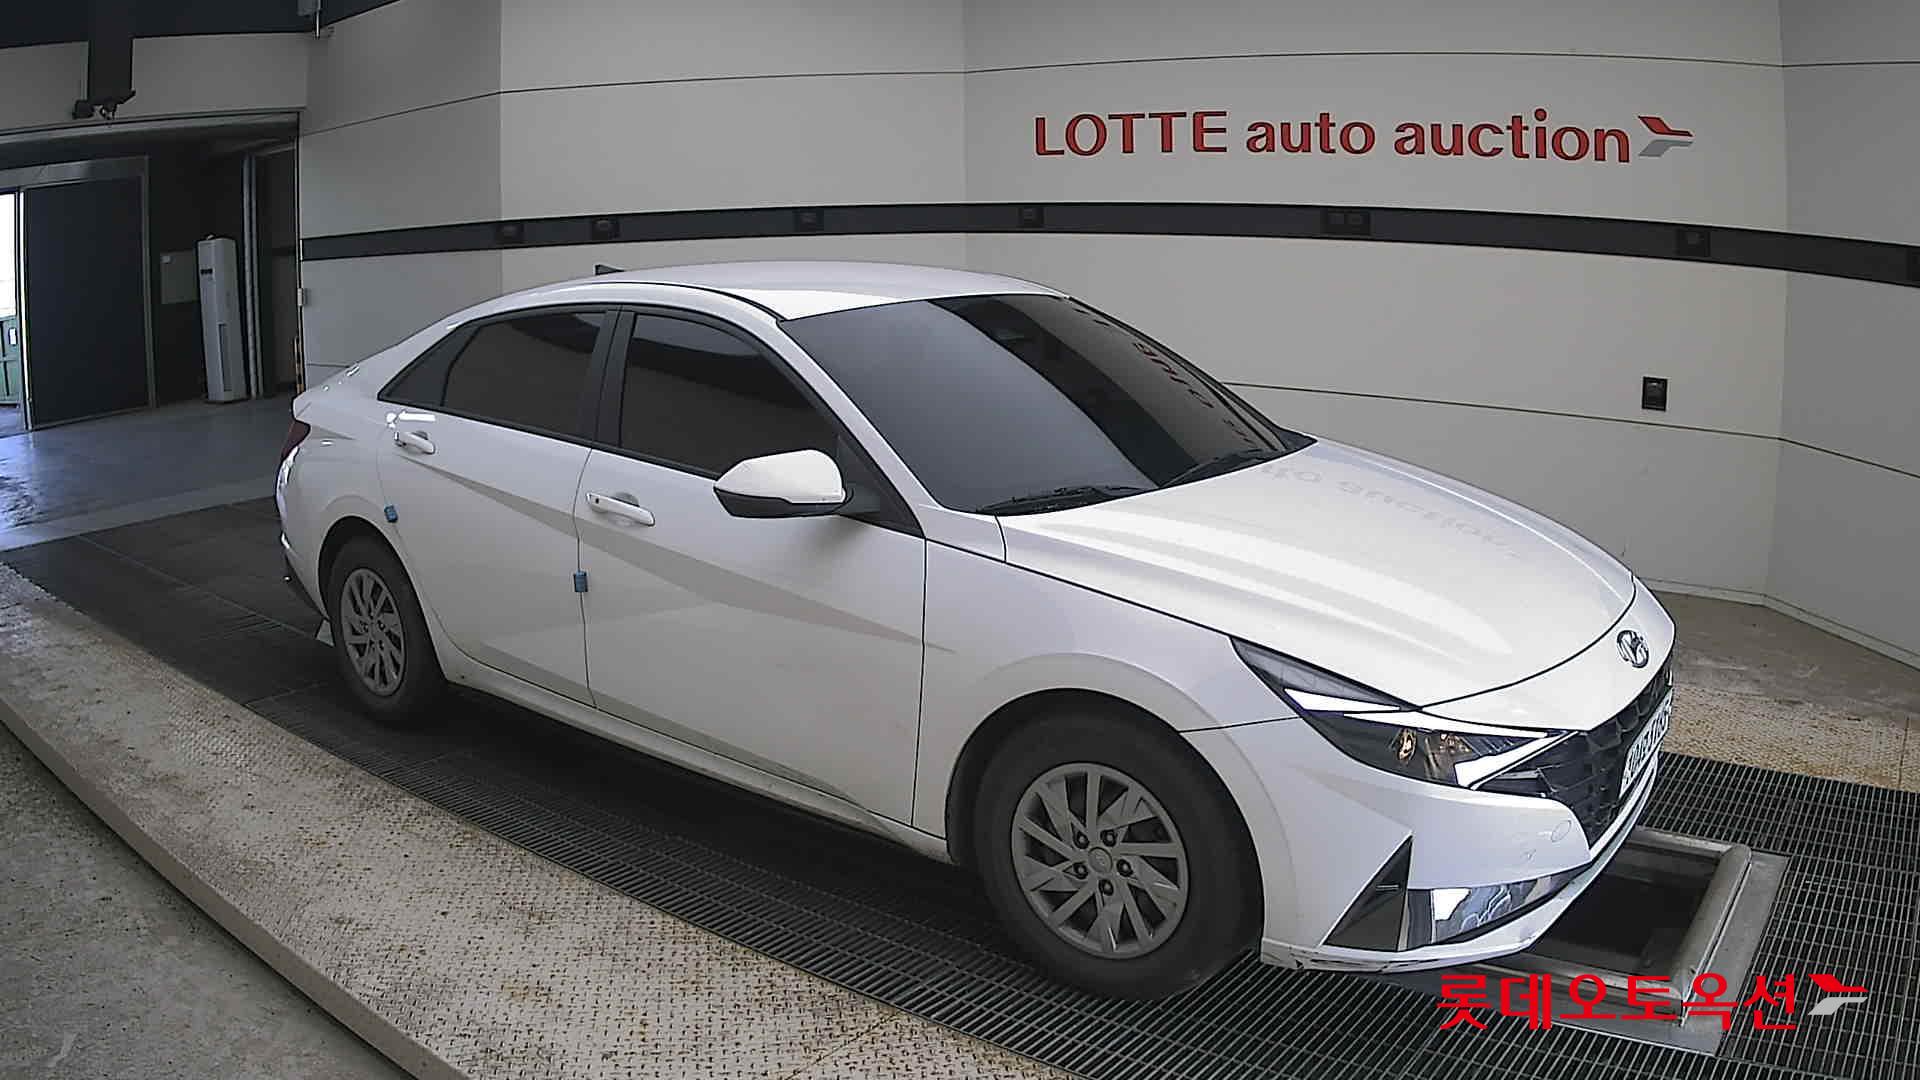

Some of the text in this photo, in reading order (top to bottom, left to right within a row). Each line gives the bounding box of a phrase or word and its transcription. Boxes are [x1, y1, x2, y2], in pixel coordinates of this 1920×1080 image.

[1035, 107, 1631, 163] LOTTE auto auction
